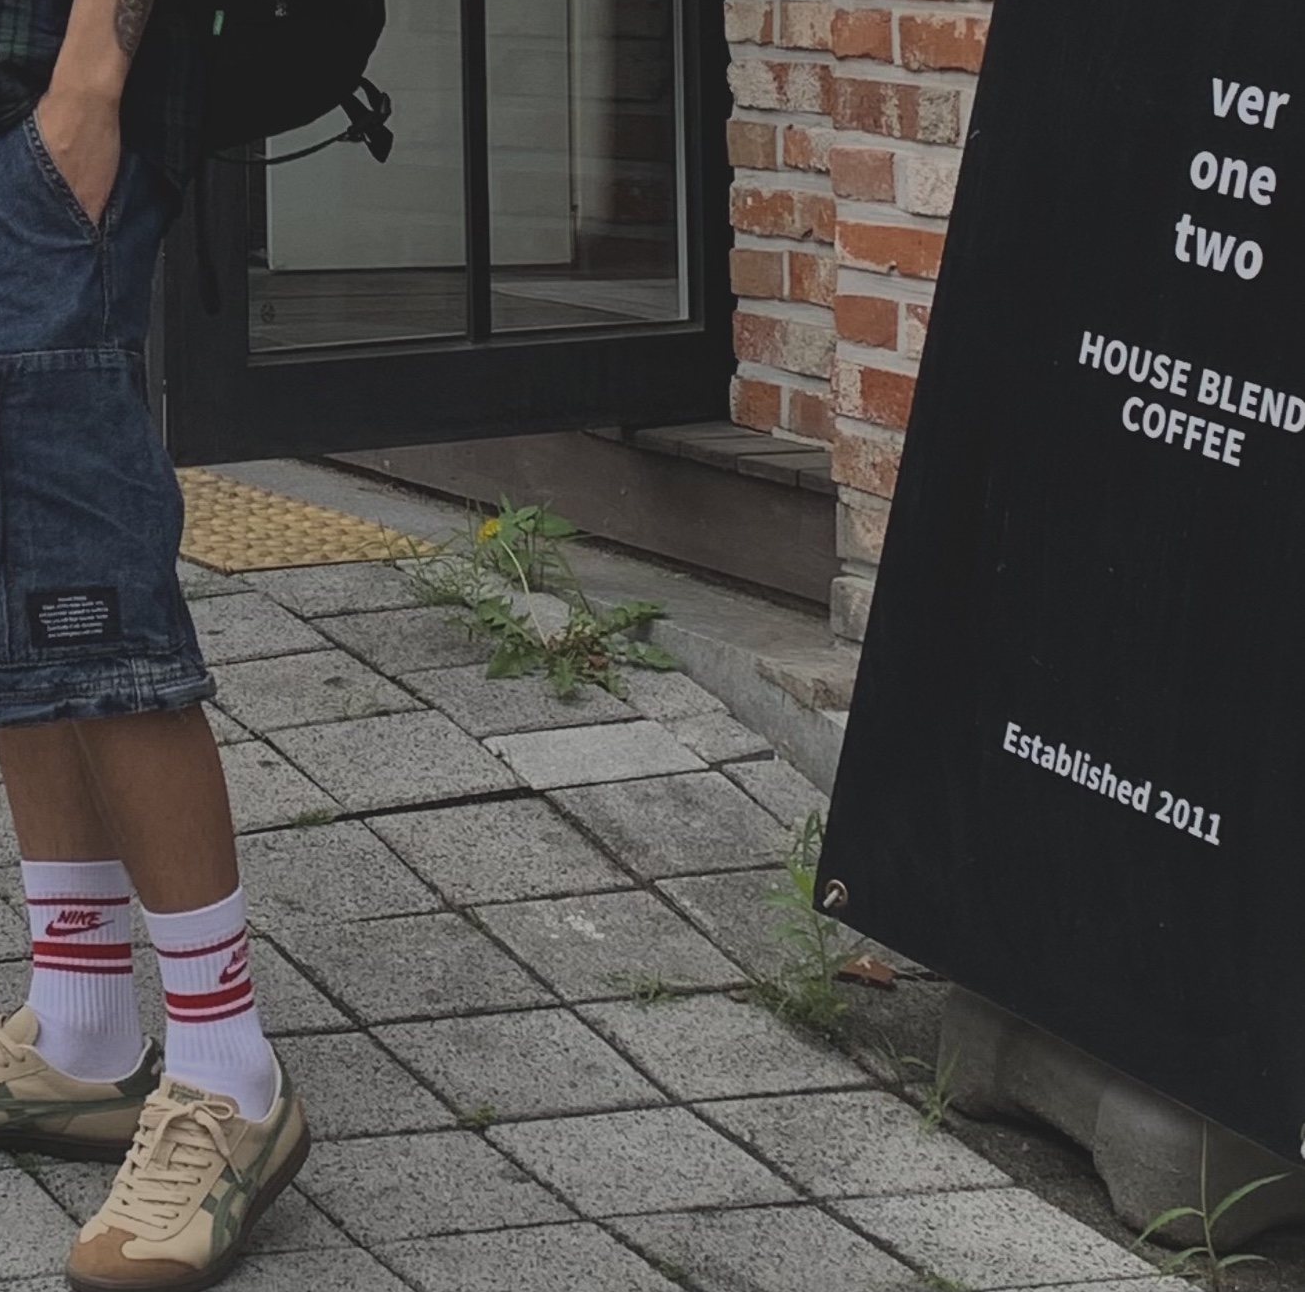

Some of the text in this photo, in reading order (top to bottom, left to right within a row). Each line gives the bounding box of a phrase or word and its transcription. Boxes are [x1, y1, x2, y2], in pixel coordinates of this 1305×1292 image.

[1212, 77, 1290, 130] ver
[1190, 150, 1277, 206] one
[1174, 213, 1264, 280] two
[1078, 330, 1305, 434] HOUSE BLEND
[1121, 396, 1246, 467] COFFEE
[1002, 720, 1222, 846] Established 2011
[56, 909, 104, 927] NIKE
